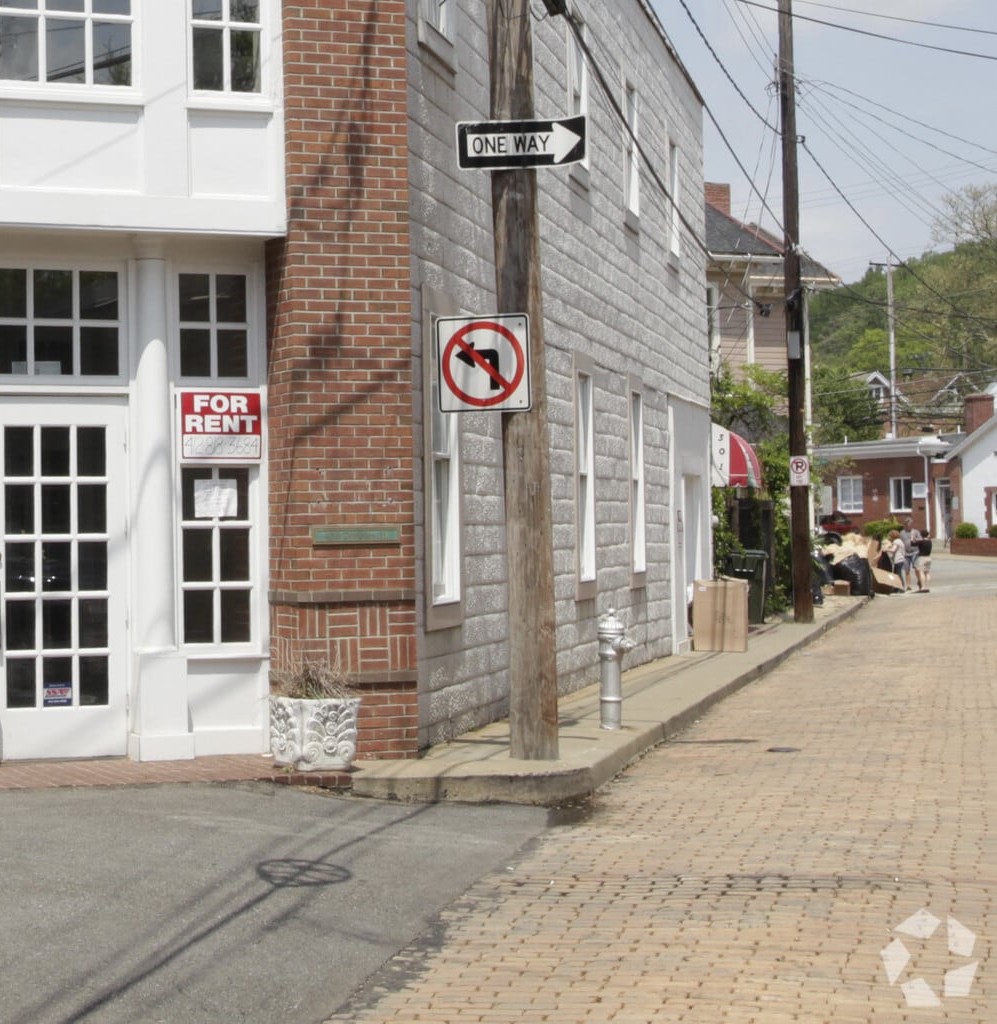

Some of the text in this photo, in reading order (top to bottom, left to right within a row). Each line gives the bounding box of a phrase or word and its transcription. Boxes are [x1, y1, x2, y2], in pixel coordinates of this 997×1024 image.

[472, 135, 550, 154] ONE WAY
[193, 394, 249, 413] FOR
[185, 414, 258, 433] RENT
